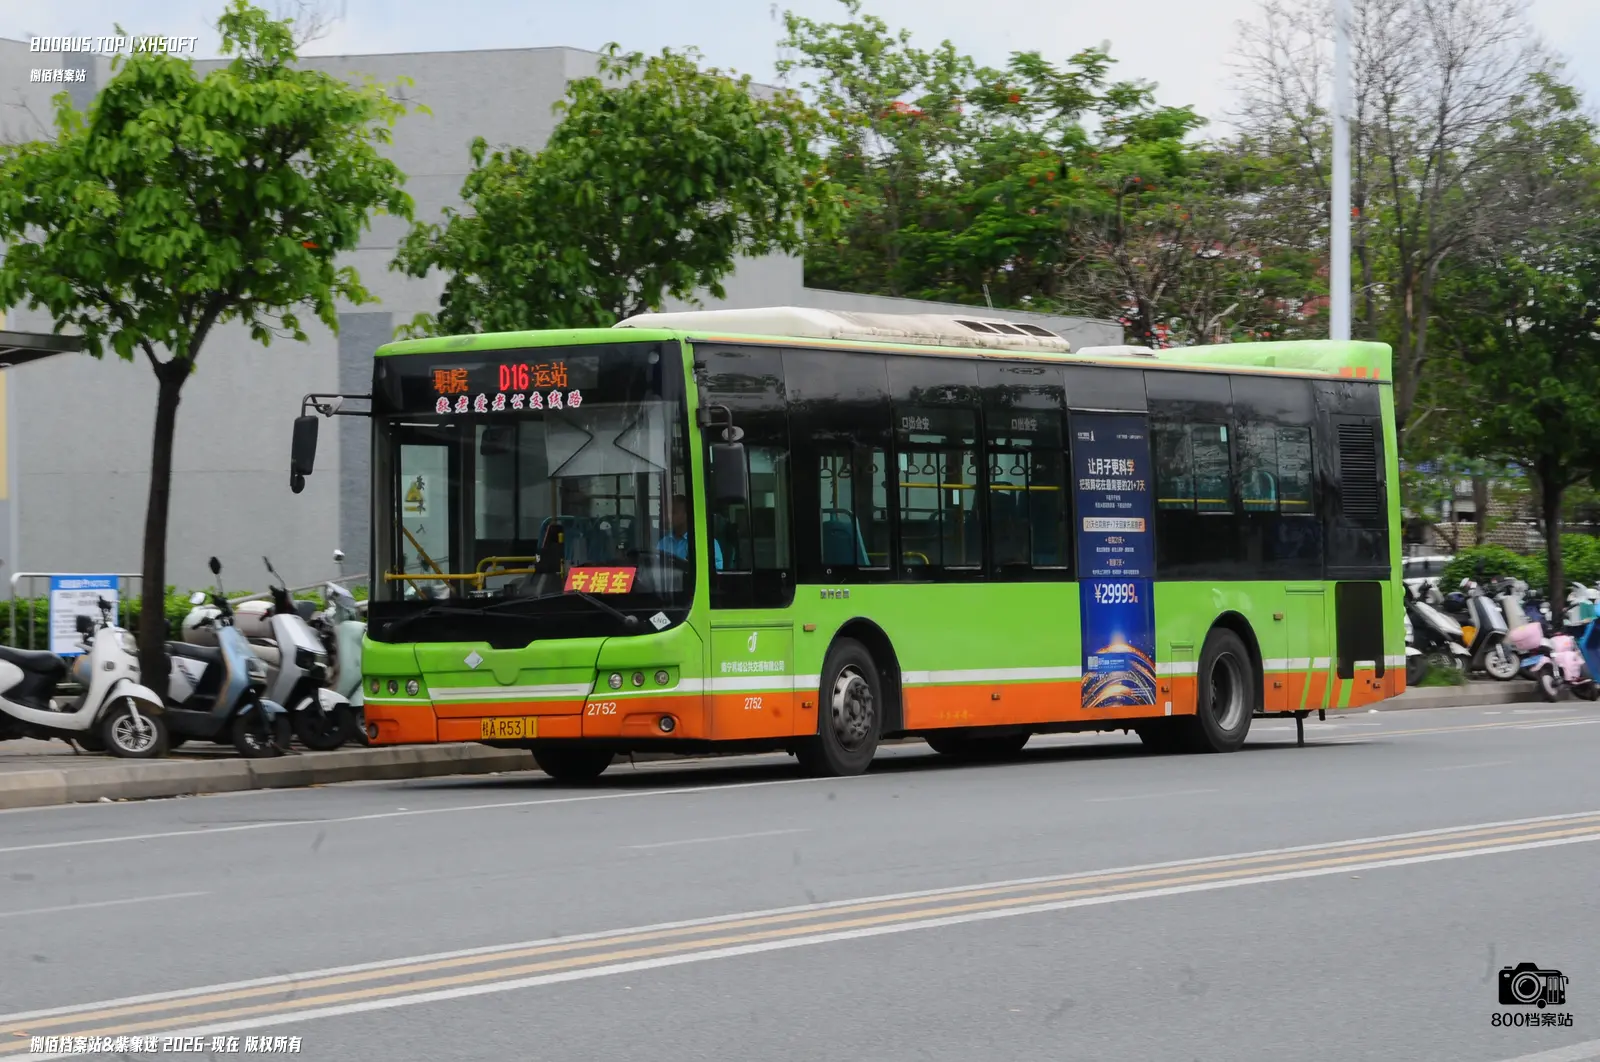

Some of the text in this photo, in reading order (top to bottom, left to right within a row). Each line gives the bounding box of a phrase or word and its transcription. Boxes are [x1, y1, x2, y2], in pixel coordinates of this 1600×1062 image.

[433, 361, 569, 394] 职院 D16 运站
[435, 389, 583, 415] 敬老爱老公交线路
[1087, 458, 1136, 476] 让月子更科学
[571, 571, 631, 593] 支援车
[587, 702, 617, 716] 2752
[744, 697, 762, 710] 2752
